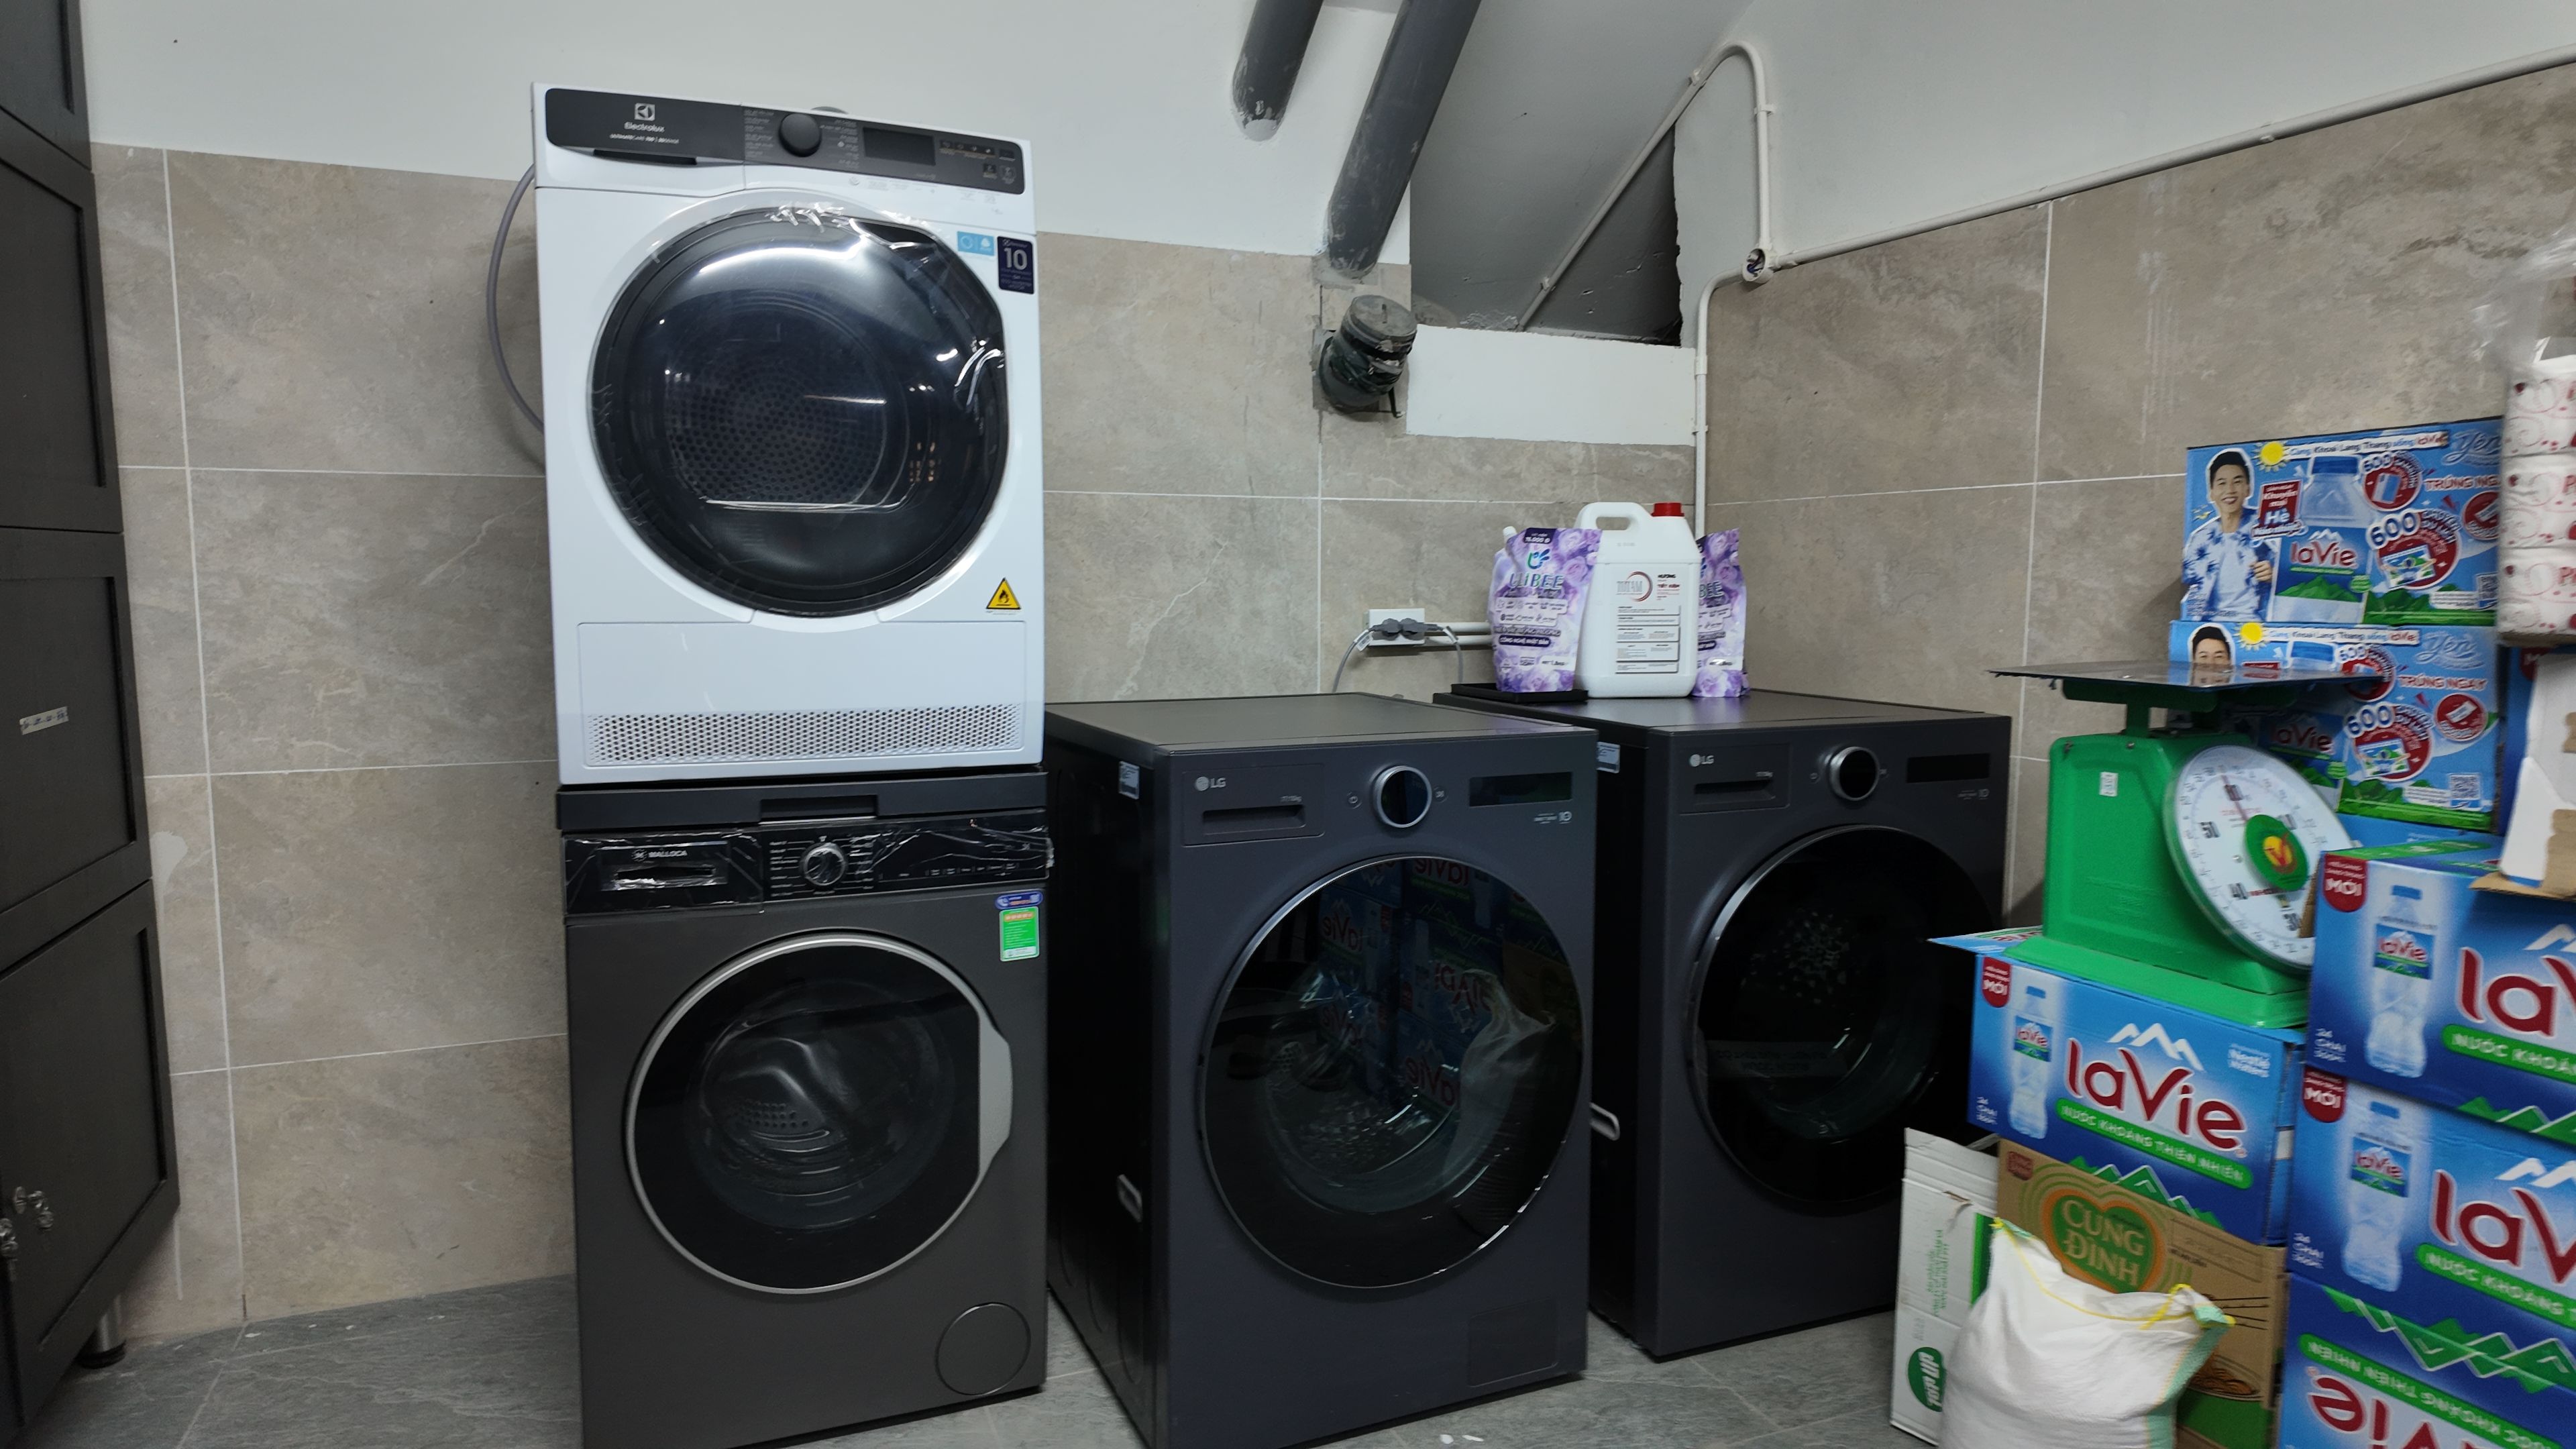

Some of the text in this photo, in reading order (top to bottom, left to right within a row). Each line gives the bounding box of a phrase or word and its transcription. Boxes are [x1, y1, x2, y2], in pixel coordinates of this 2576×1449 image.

[624, 121, 665, 133] Electrolux
[1004, 248, 1028, 270] 10
[2363, 452, 2392, 472] 600
[2473, 474, 2501, 490] NGA
[2263, 507, 2291, 525] Hè
[2371, 512, 2416, 547] 600
[2290, 541, 2357, 568] laVie
[1699, 581, 1724, 598] BEE
[2348, 704, 2392, 735] 600
[2271, 722, 2334, 754] laVie
[1701, 755, 1715, 765] LG
[1210, 777, 1227, 788] LG
[648, 850, 688, 858] MALLOCA
[2455, 947, 2576, 1037] laV
[2451, 1032, 2576, 1076] NƯỚC KHOÁ
[2066, 1038, 2246, 1150] laVie
[2061, 1105, 2244, 1181] NƯỚC KHOÁNG THIÊN NHIÊN
[2061, 1199, 2145, 1256] CUNG
[2431, 1169, 2576, 1285] laV
[2483, 1277, 2565, 1316] KHOÁNG
[2306, 1340, 2362, 1373] NHIÊN
[1917, 1351, 1943, 1408] TOP UP
[2363, 1366, 2419, 1399] THIÊN
